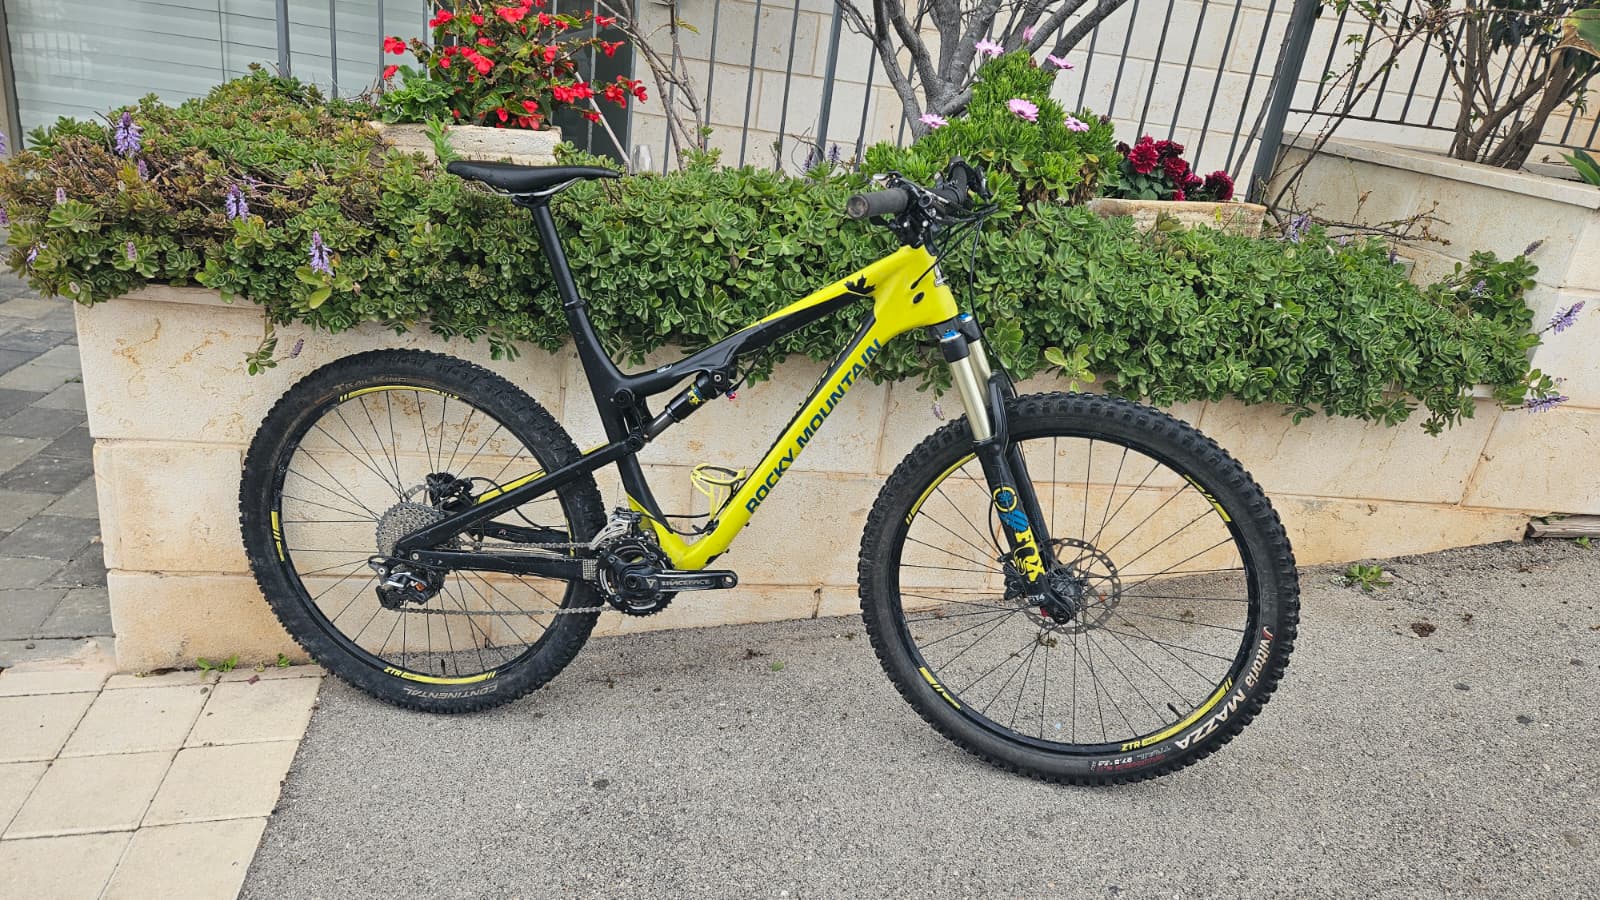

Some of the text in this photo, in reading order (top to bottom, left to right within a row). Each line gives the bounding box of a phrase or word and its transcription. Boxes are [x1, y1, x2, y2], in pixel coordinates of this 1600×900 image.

[745, 338, 882, 514] ROCKY MOUNTAIN
[1014, 526, 1046, 582] FOX
[384, 666, 402, 677] ZTR
[1245, 639, 1272, 688] vittoria
[403, 684, 498, 699] CONTINENTAL
[1175, 688, 1247, 750] MAZZA
[1121, 741, 1140, 751] ZTR
